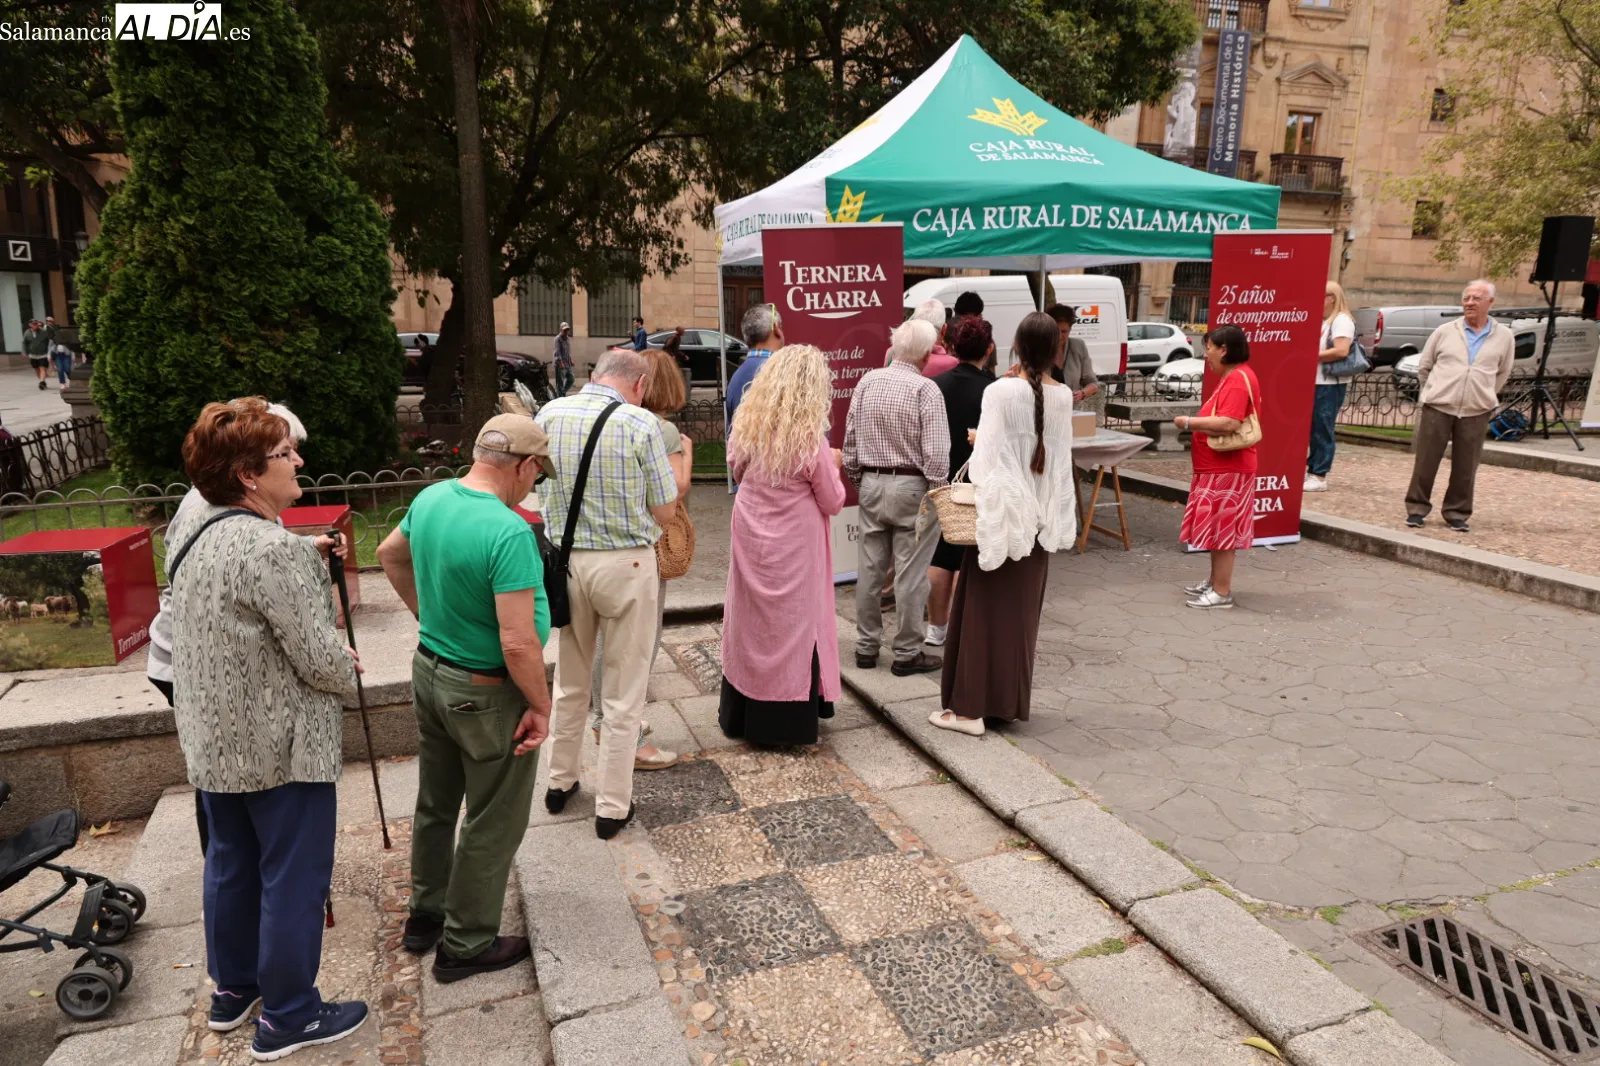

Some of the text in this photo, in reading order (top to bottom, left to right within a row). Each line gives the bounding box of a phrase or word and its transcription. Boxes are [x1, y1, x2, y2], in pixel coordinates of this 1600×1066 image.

[1224, 33, 1234, 44] la
[1223, 44, 1233, 60] de
[1216, 61, 1232, 125] Documental
[1224, 35, 1246, 162] Memoria Histórica
[969, 139, 1095, 157] CAJA RURAL
[1213, 127, 1224, 161] Centro
[976, 151, 1104, 166] DE SALAMANCA
[912, 204, 1251, 237] CAJA RURAL DE SALAMANCA
[779, 260, 887, 285] TERNERA
[786, 286, 882, 311] CHARRA
[1217, 284, 1276, 305] 25 años
[1216, 307, 1308, 326] de compromiso
[1253, 327, 1292, 343] tierra.
[850, 345, 865, 360] de
